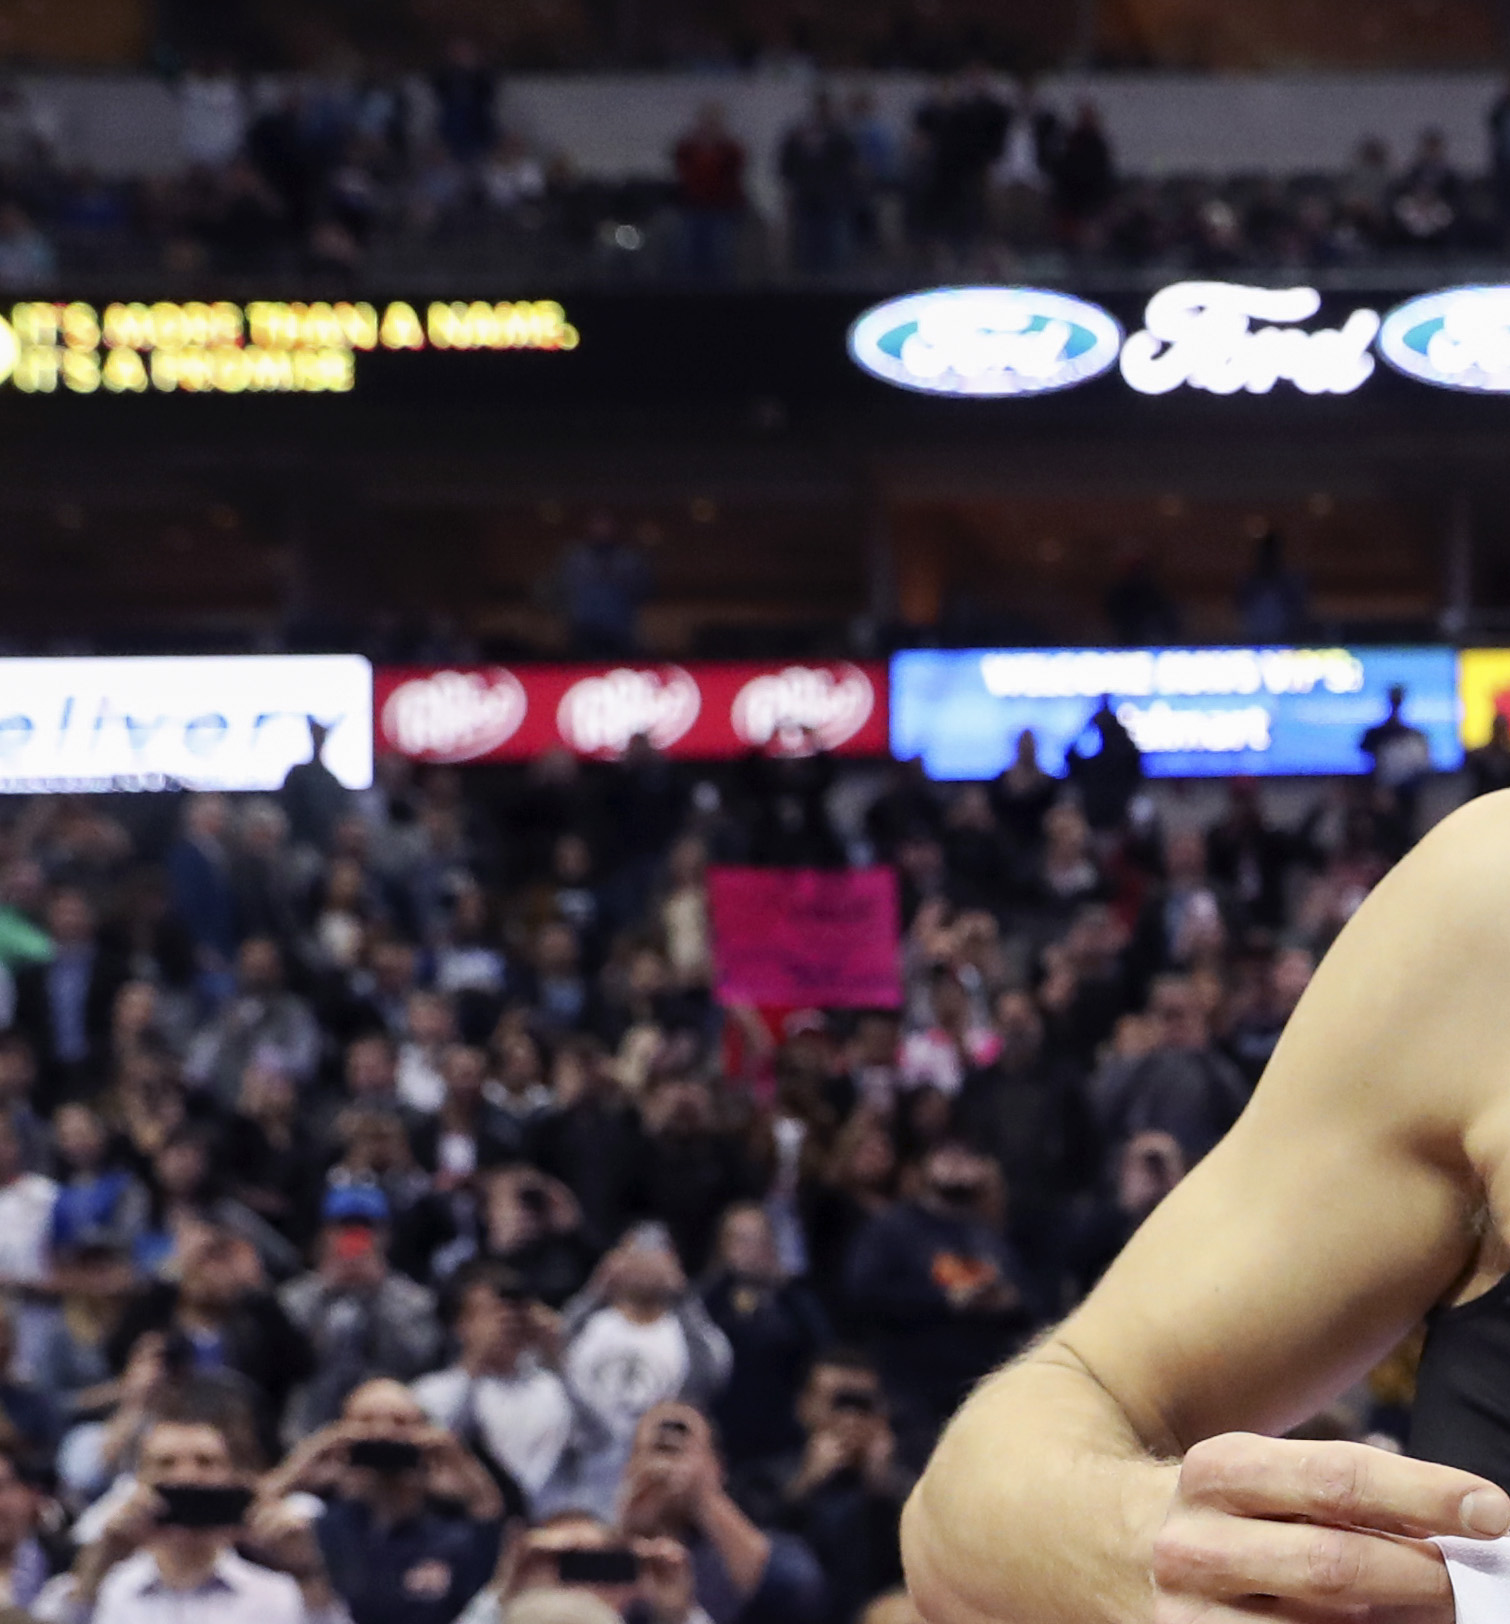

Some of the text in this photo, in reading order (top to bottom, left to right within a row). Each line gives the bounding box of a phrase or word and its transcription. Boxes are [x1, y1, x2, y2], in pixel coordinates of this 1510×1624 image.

[379, 301, 424, 349] A
[1120, 280, 1380, 395] Ford
[102, 346, 148, 393] A
